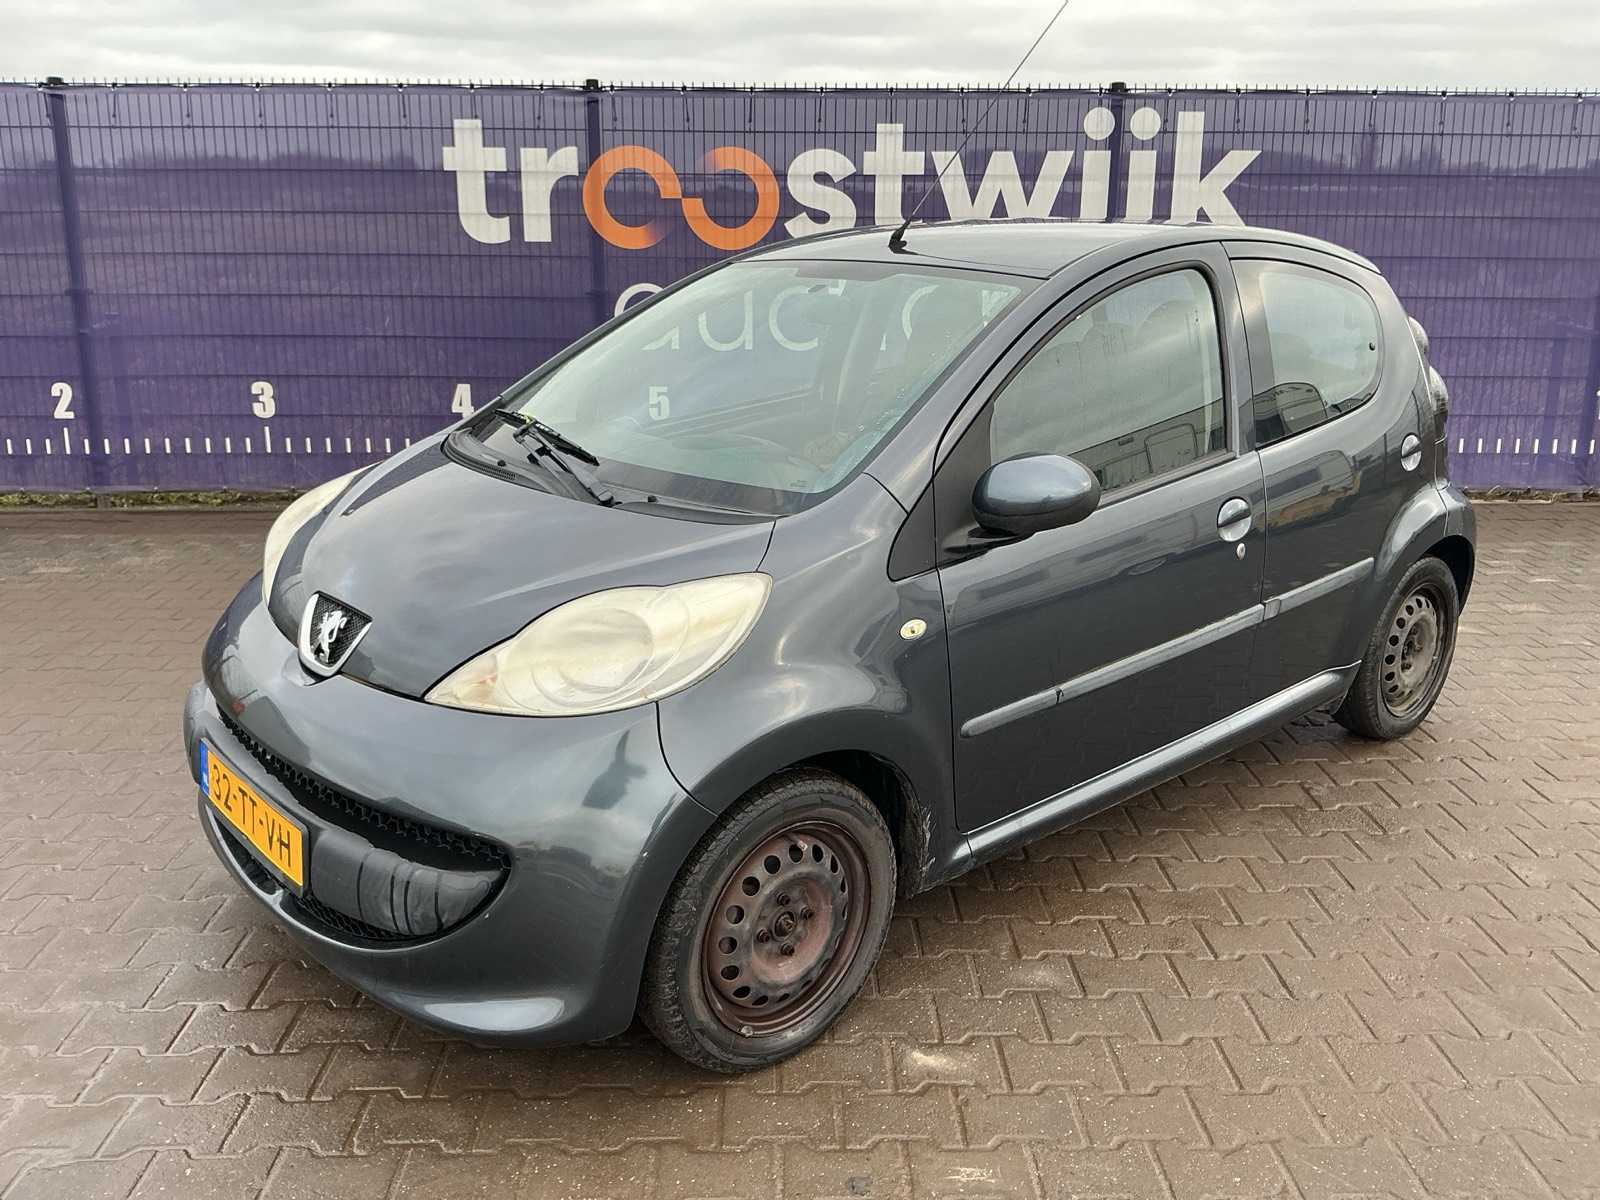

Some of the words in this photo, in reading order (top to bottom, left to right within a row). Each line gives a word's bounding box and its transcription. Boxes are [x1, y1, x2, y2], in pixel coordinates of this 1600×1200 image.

[443, 107, 1262, 250] troostwijk
[51, 382, 75, 419] 2
[250, 381, 276, 418] 3
[451, 383, 475, 418] 4
[648, 386, 670, 421] 5
[211, 763, 291, 868] 32-TT-VH
